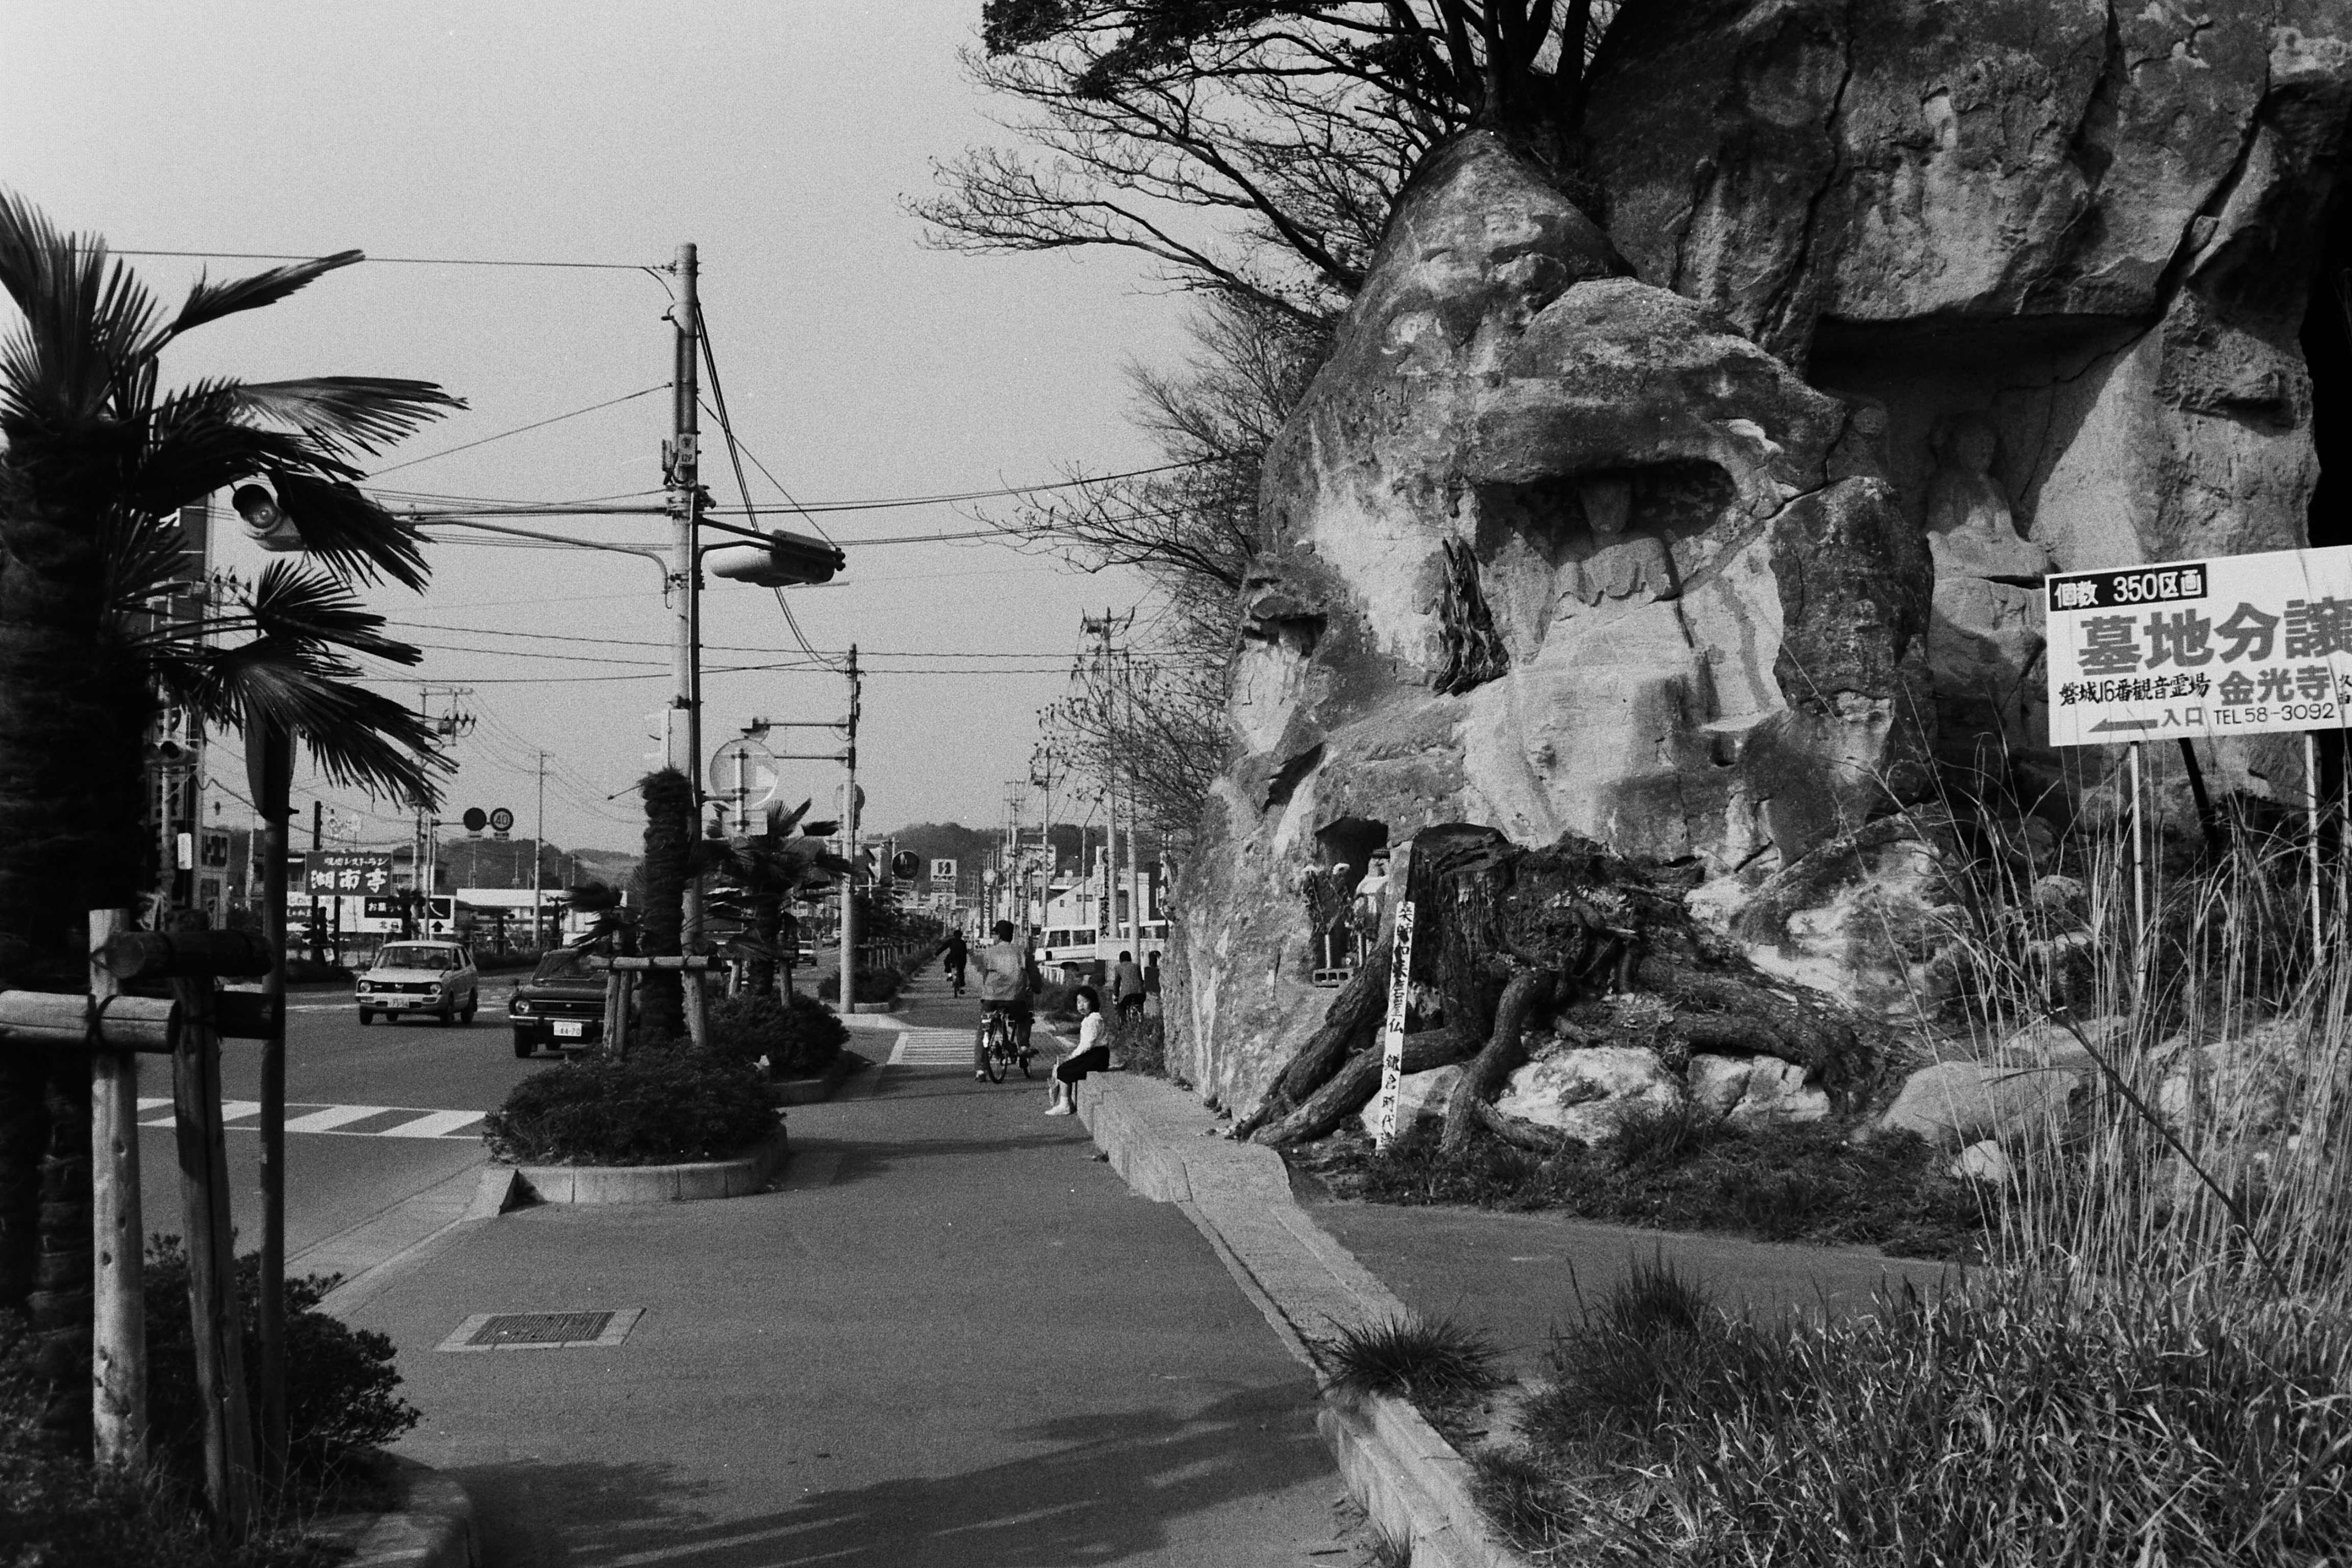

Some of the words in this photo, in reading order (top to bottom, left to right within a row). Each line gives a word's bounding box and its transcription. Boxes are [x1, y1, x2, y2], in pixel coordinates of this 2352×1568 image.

[2054, 580, 2099, 608] 個数
[2113, 569, 2202, 603] 350区画
[2078, 596, 2351, 676] 墓地分譲
[2218, 665, 2331, 706] 金光寺
[2161, 706, 2203, 727] 入口
[2214, 709, 2242, 725] TEL
[2245, 702, 2335, 723] 58-3092
